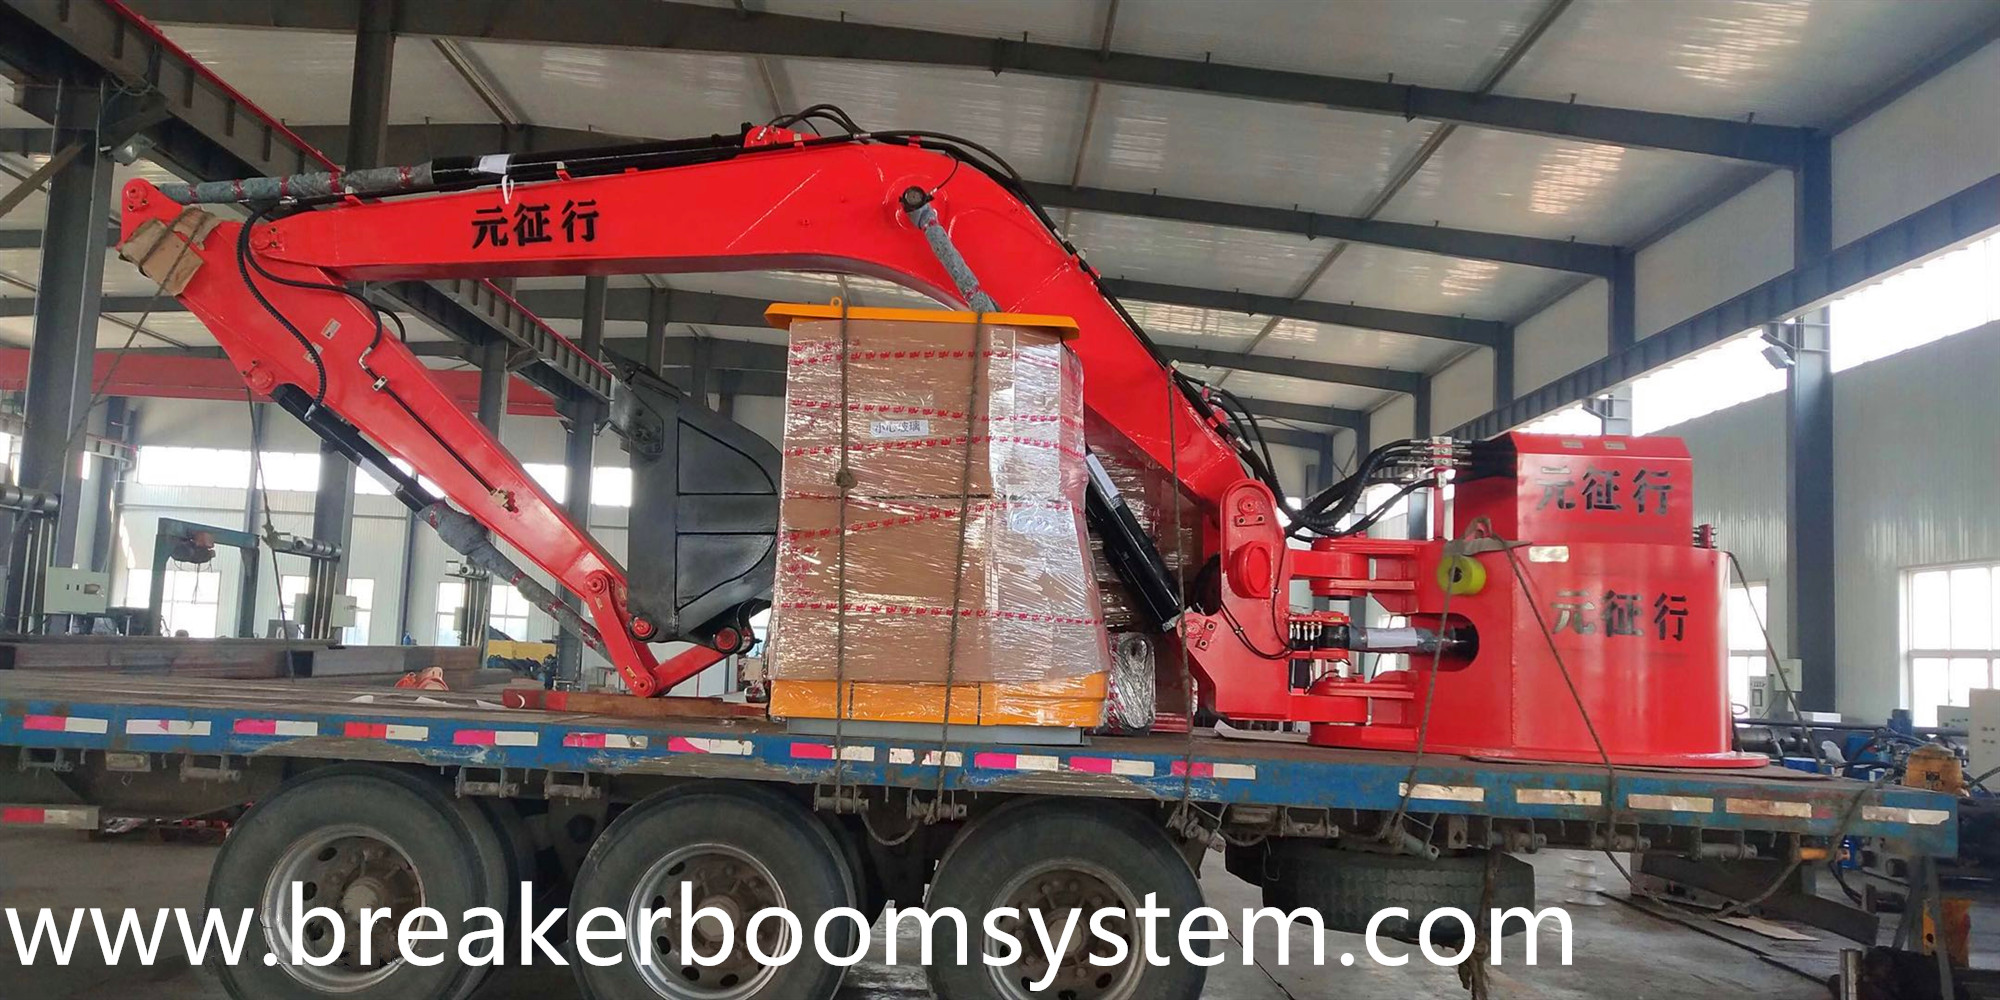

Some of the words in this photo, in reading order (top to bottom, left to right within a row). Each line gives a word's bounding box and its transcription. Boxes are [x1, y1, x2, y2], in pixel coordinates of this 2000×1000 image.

[471, 199, 599, 249] 元征行
[1536, 465, 1672, 516] 元征行
[1551, 589, 1689, 642] 元征行
